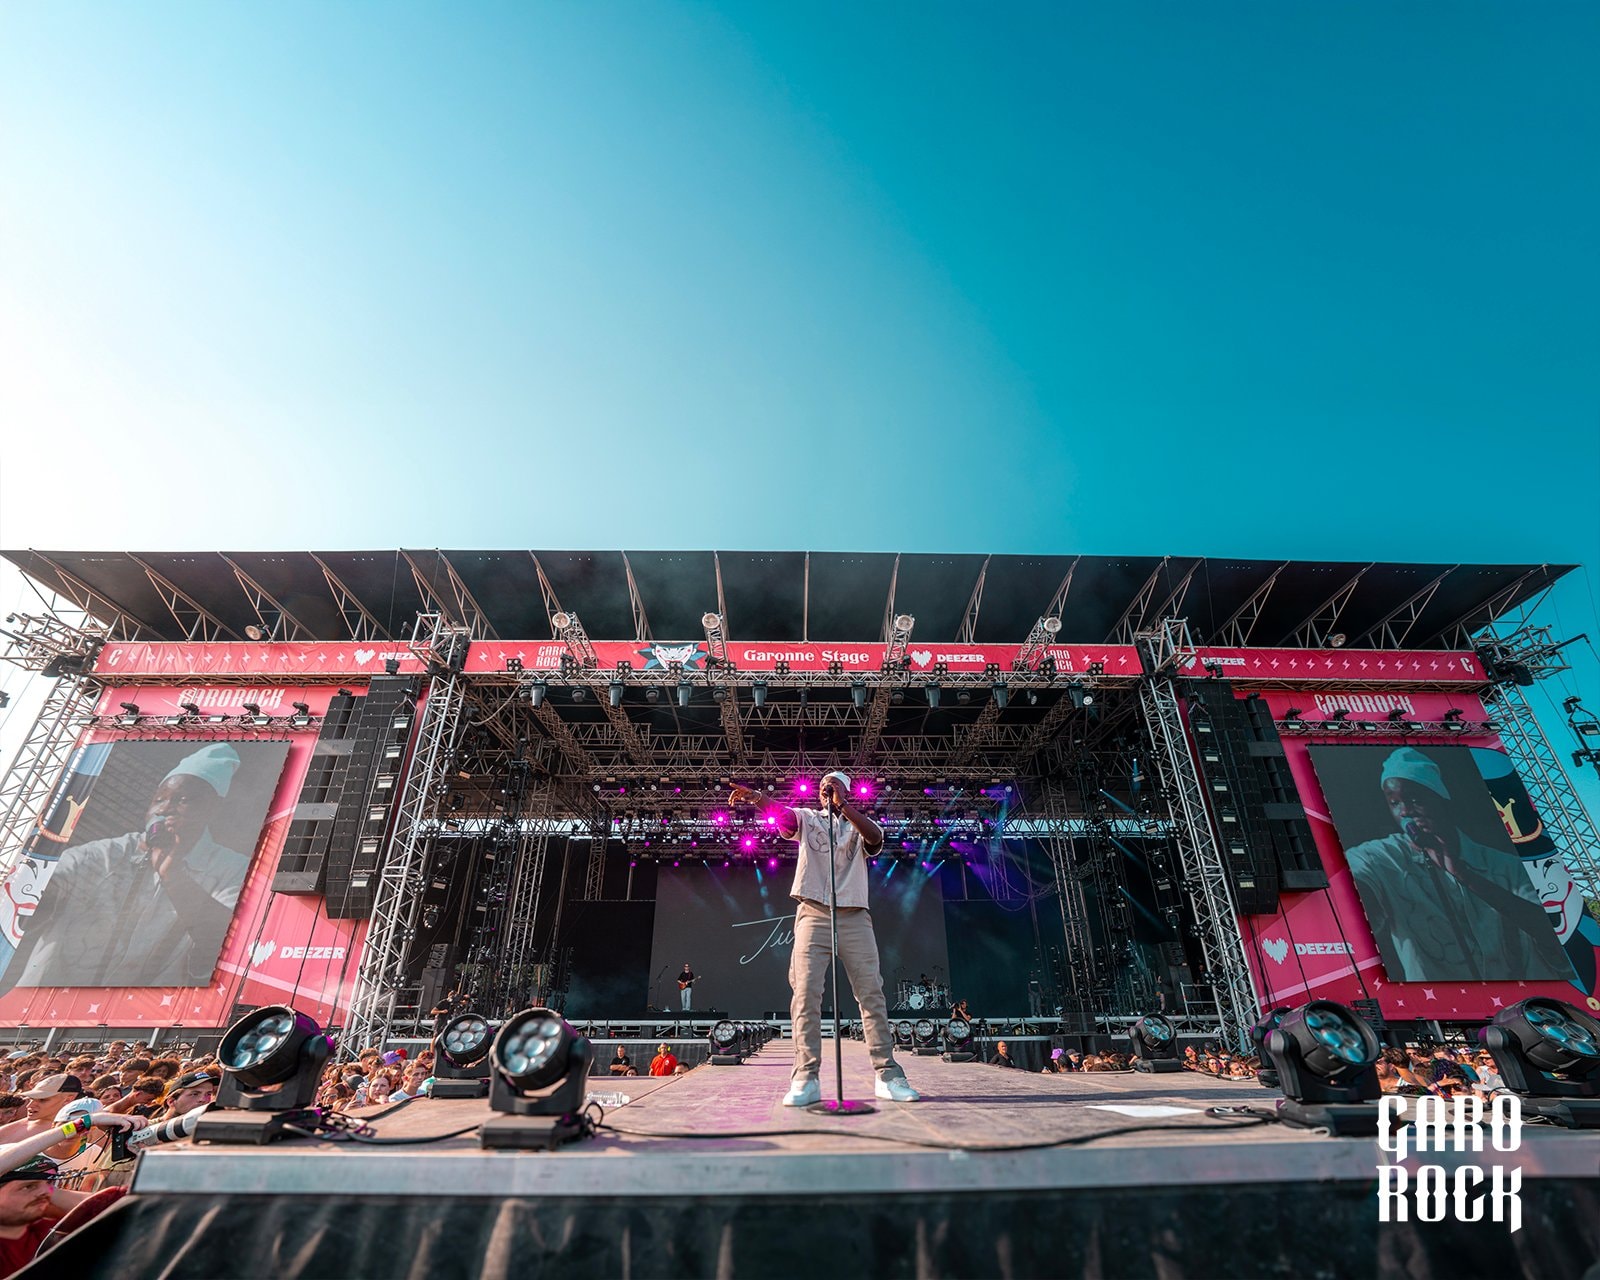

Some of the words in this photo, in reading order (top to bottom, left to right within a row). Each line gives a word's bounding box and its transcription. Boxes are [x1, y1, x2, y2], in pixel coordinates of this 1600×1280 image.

[377, 652, 419, 660] DEEZE
[743, 649, 815, 661] Garonne
[821, 650, 870, 664] Stage
[936, 654, 985, 663] DEEZER
[280, 946, 345, 959] DEEZER
[1294, 942, 1355, 955] DEEZER
